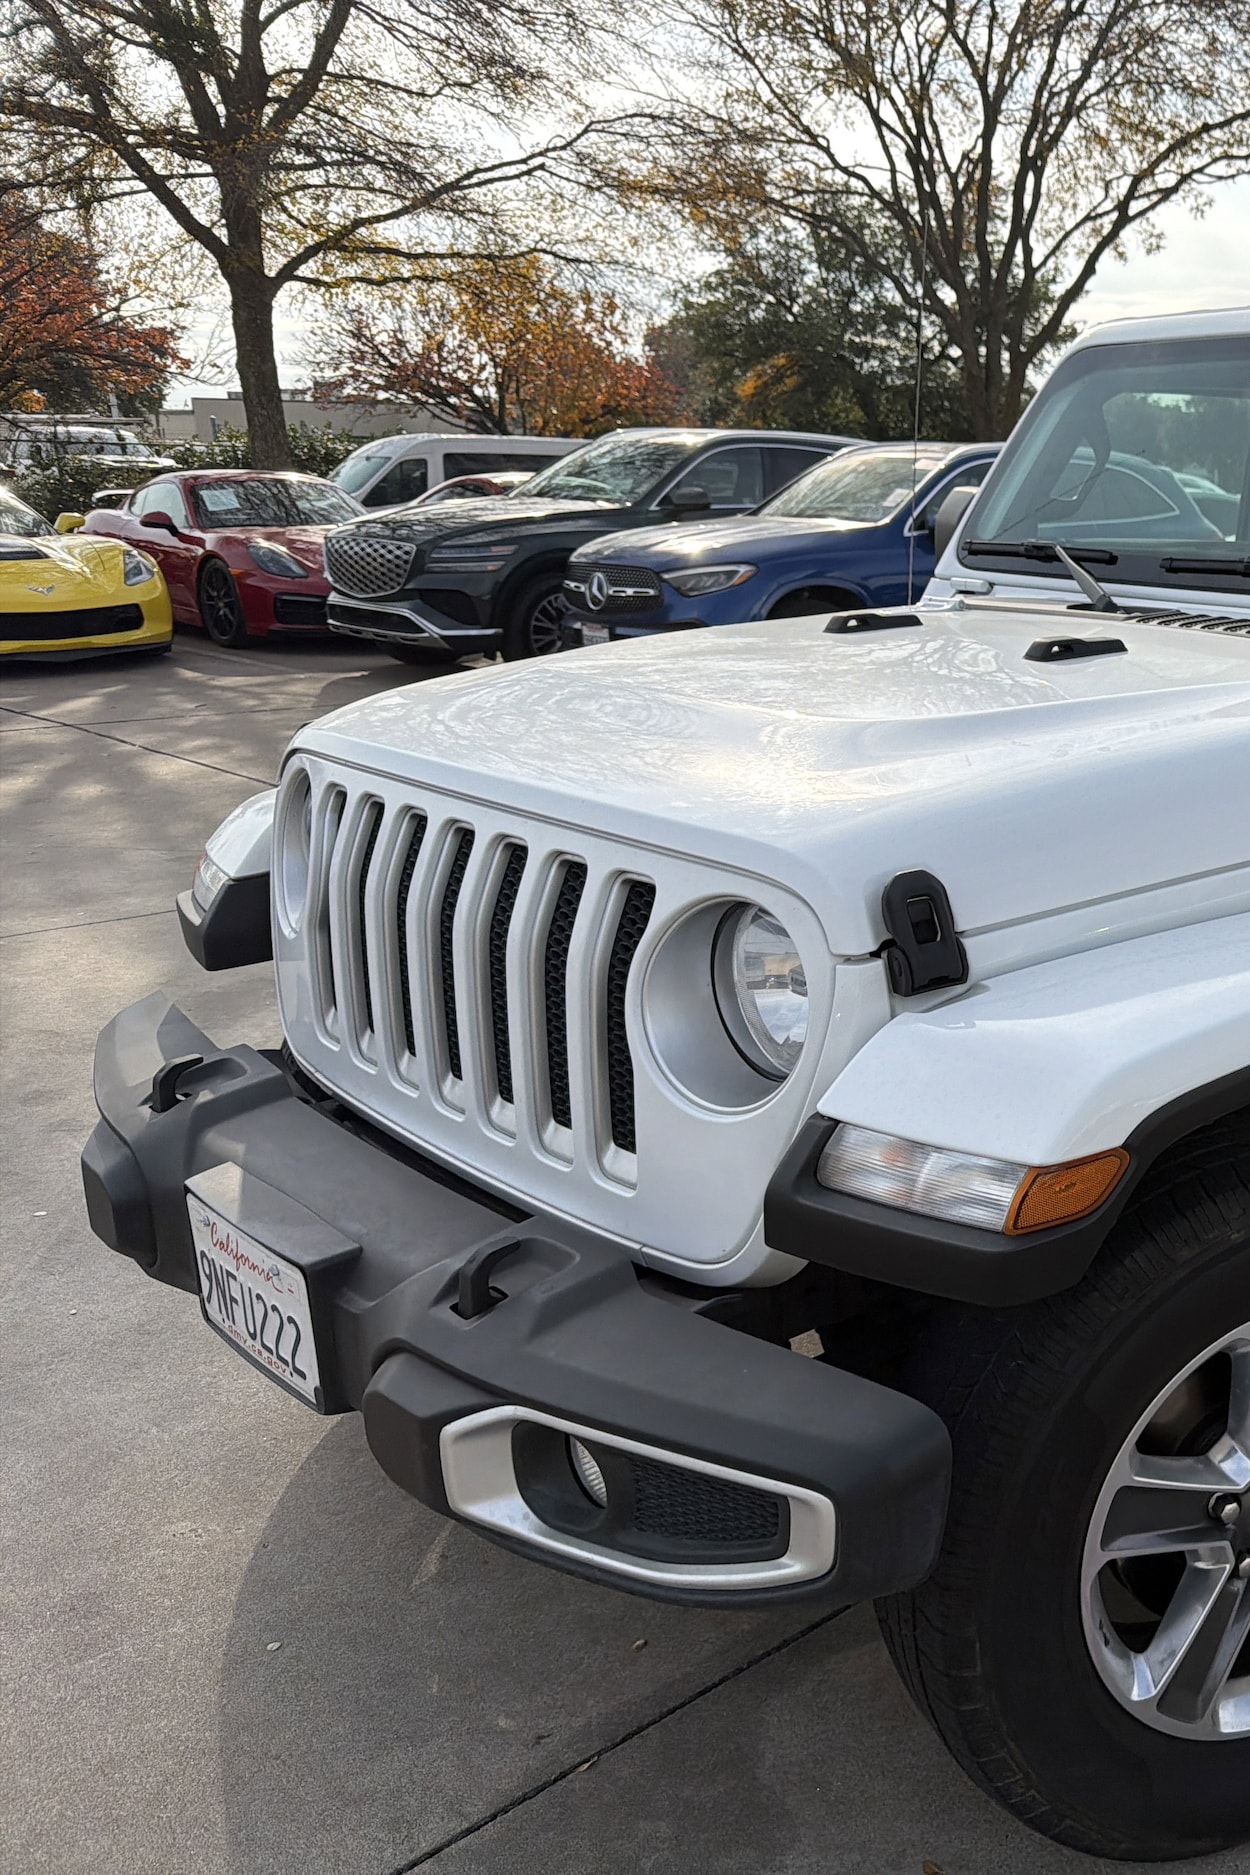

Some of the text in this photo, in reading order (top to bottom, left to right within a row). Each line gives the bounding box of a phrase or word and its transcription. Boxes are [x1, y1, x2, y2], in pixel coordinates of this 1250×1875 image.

[210, 1221, 284, 1294] California
[200, 1249, 307, 1381] 9NFU222
[227, 1324, 287, 1375] dmv.ca.gov
